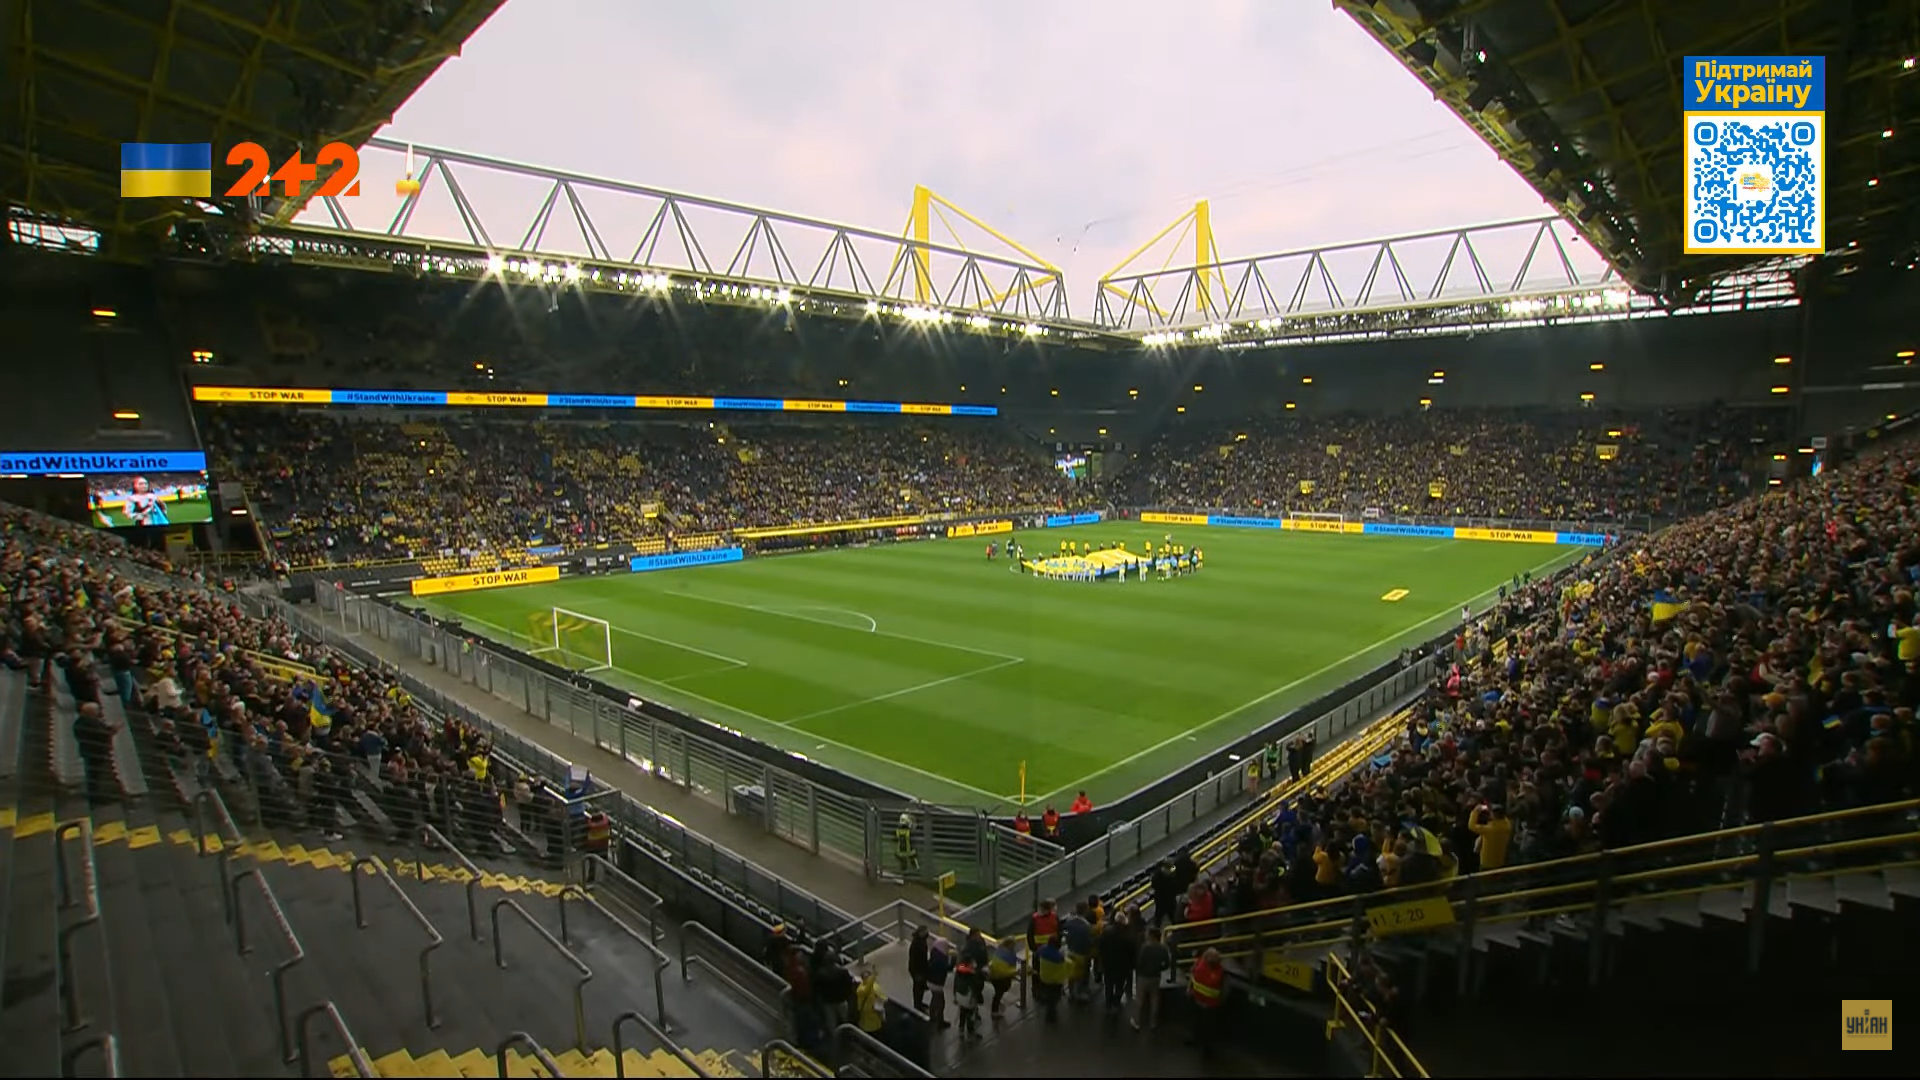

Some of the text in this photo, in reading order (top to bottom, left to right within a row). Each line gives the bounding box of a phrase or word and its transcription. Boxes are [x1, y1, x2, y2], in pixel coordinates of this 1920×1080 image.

[249, 391, 305, 400] STOP WAR
[347, 393, 436, 402] #StandWithUkraine
[487, 395, 528, 403] STOP WAR
[666, 398, 682, 406] STOP
[1310, 521, 1327, 529] STOP
[1373, 525, 1445, 536] #StandWithUkraine
[1490, 530, 1533, 540] STOP WAR
[649, 552, 728, 567] #StandWithUkraine
[472, 572, 528, 586] STOP WAR
